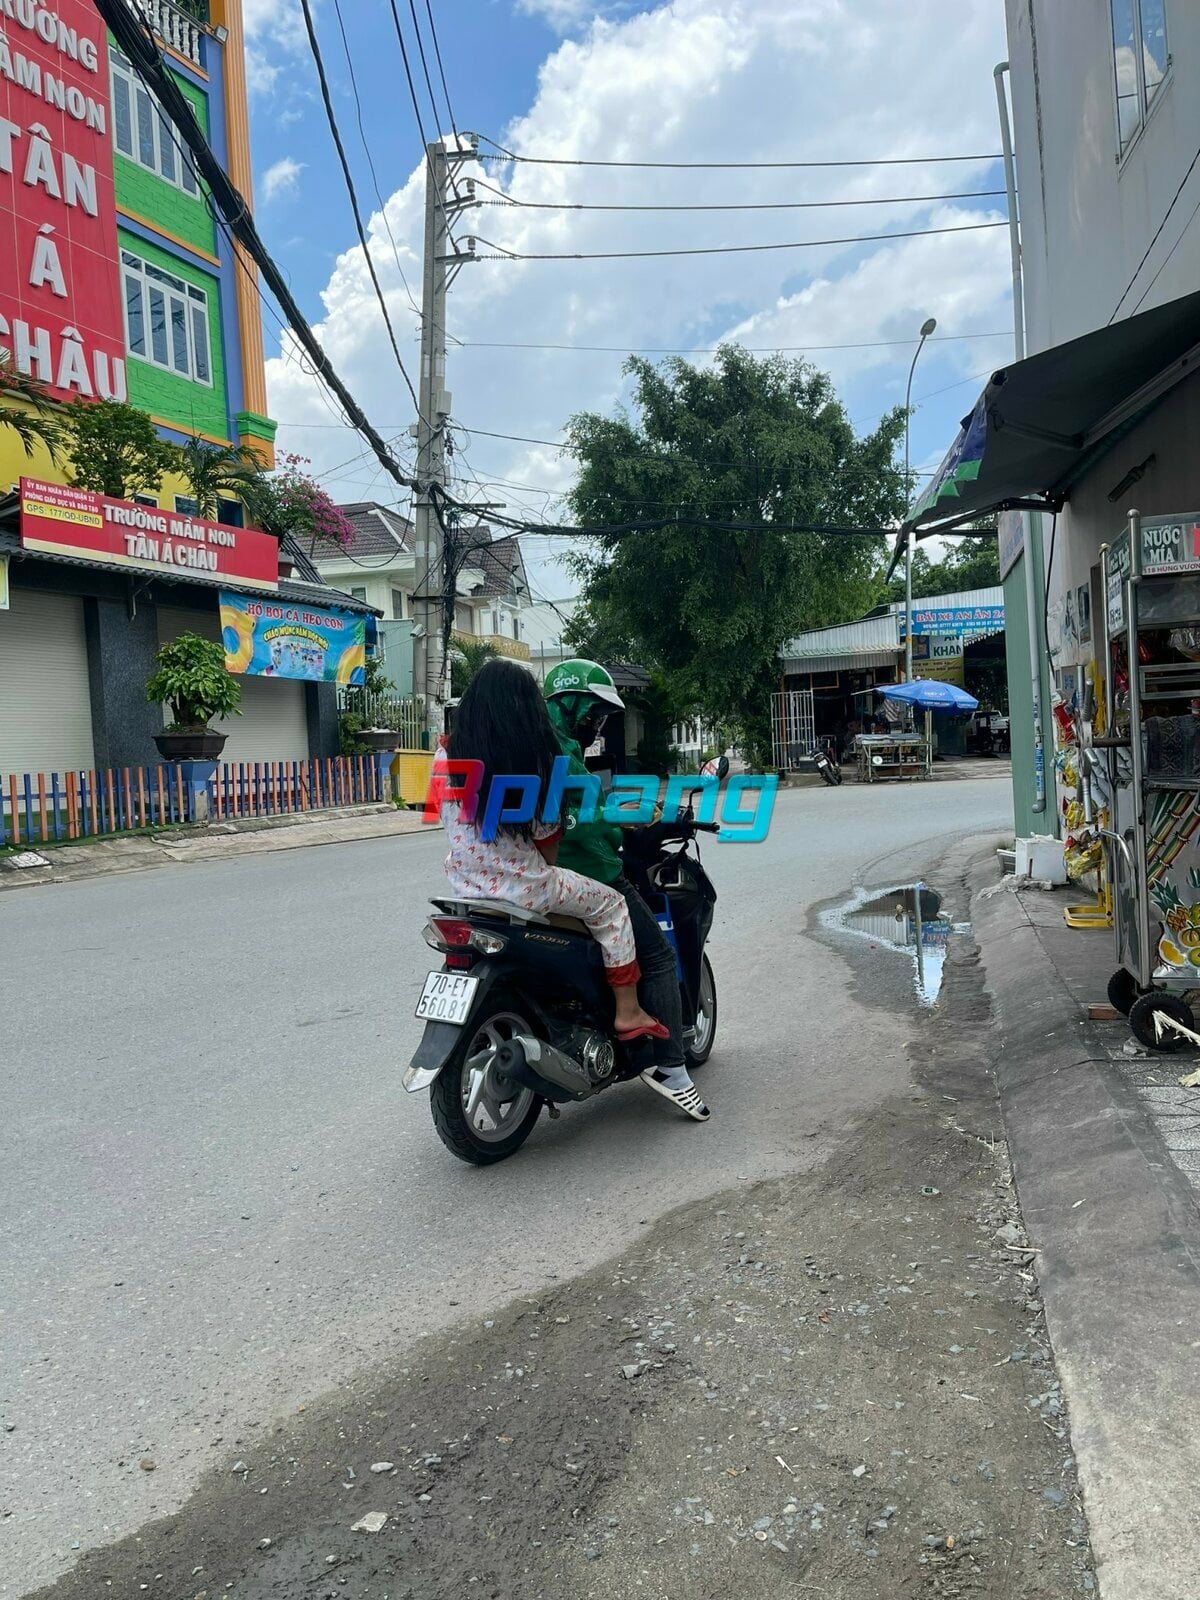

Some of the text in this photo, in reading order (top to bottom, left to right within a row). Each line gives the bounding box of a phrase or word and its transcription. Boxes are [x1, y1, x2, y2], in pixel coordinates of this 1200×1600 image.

[44, 72, 105, 135] NON
[0, 116, 99, 218] TÂN
[29, 223, 68, 299] Á
[25, 491, 44, 503] PHÒNG
[44, 495, 57, 505] GIÁO
[57, 498, 69, 508] DỤC
[69, 499, 76, 509] VÀ
[88, 505, 99, 514] TẠO
[36, 482, 47, 492] BAN
[48, 484, 62, 496] NHÂN
[63, 486, 74, 498] DÂN
[73, 489, 88, 502] QUẬN
[88, 494, 95, 502] 12
[102, 504, 236, 548] TRƯỜNG MẦM NON
[1143, 525, 1181, 547] NƯỚC
[124, 531, 218, 571] TÂN Á CHÂU
[1149, 544, 1175, 564] MÍA
[302, 612, 322, 626] HEO
[324, 617, 344, 630] CON
[938, 611, 953, 622] XE
[955, 610, 973, 621] AN
[552, 674, 580, 688] Grab
[430, 975, 469, 998] 70-E1
[418, 995, 468, 1021] 560.81
